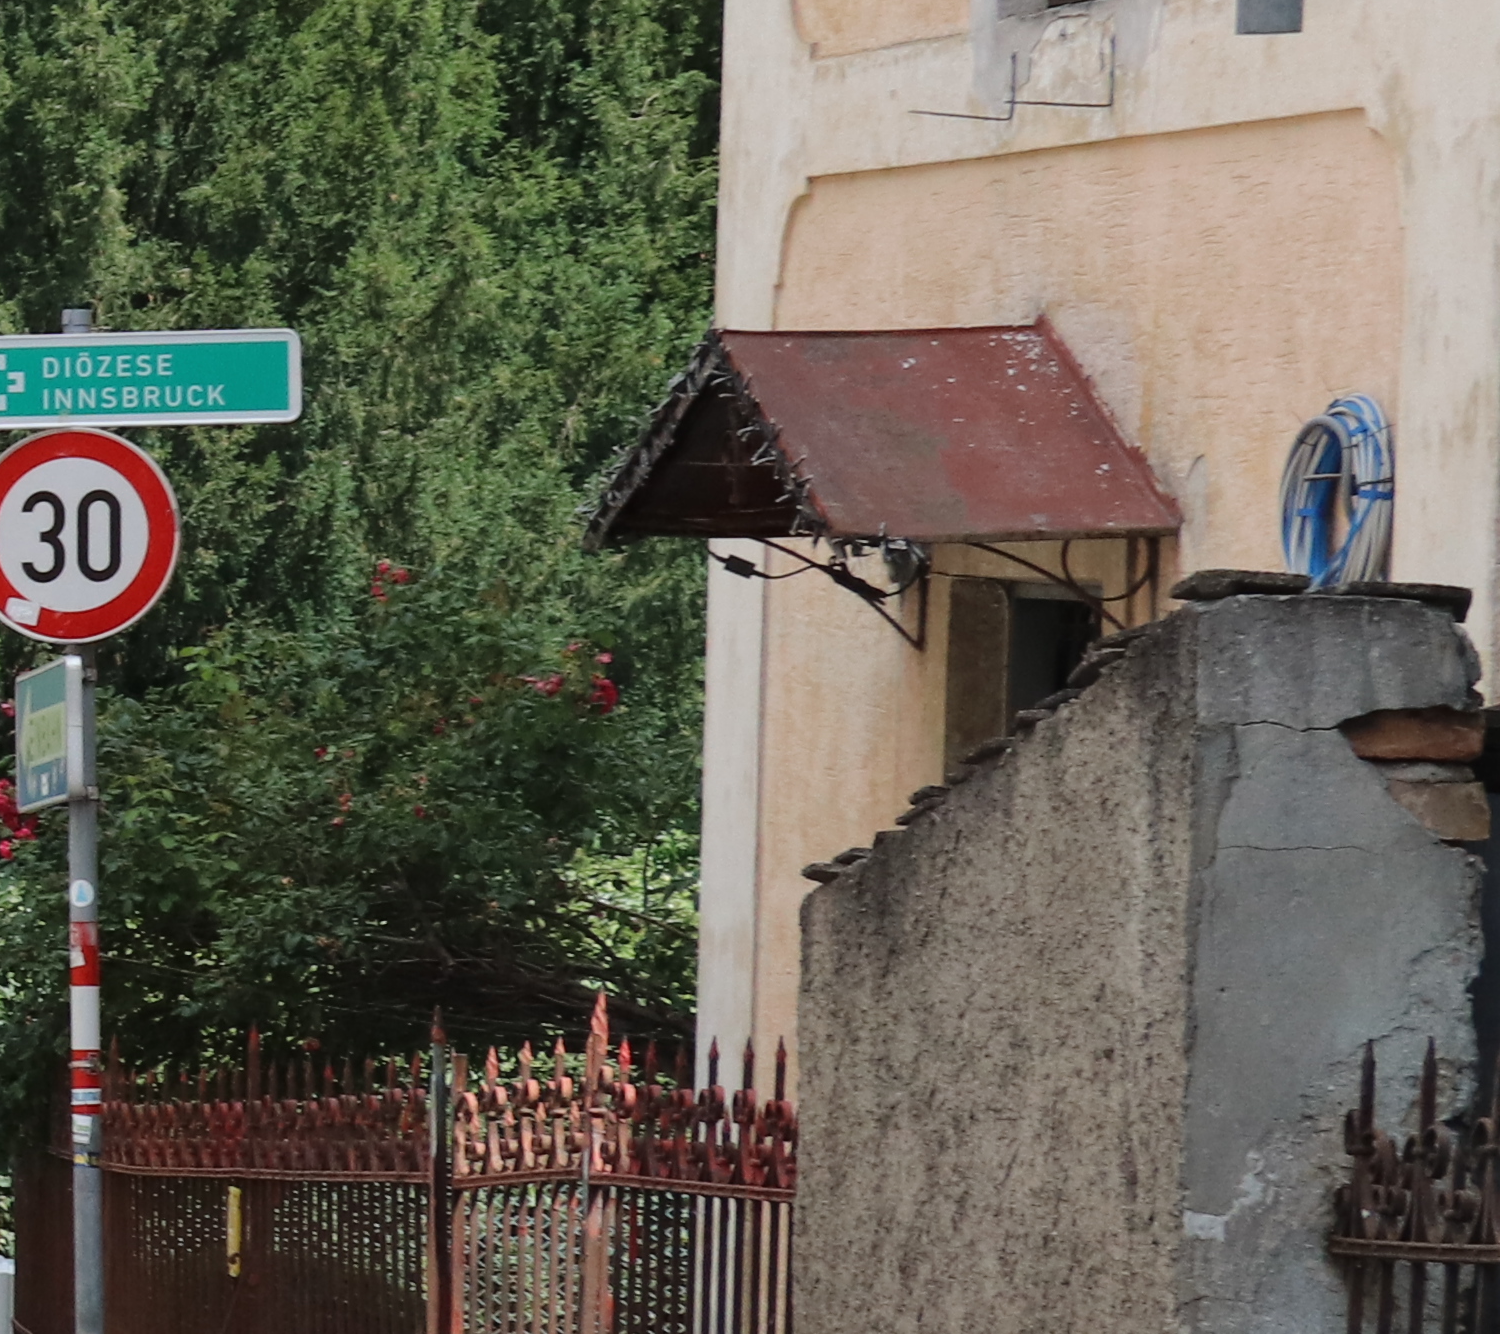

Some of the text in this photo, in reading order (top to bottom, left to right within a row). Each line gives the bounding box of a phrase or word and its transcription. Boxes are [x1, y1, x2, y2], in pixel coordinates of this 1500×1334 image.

[41, 351, 174, 380] DIÖZESE
[41, 384, 227, 408] INNSBRUCK
[20, 488, 123, 584] 30
